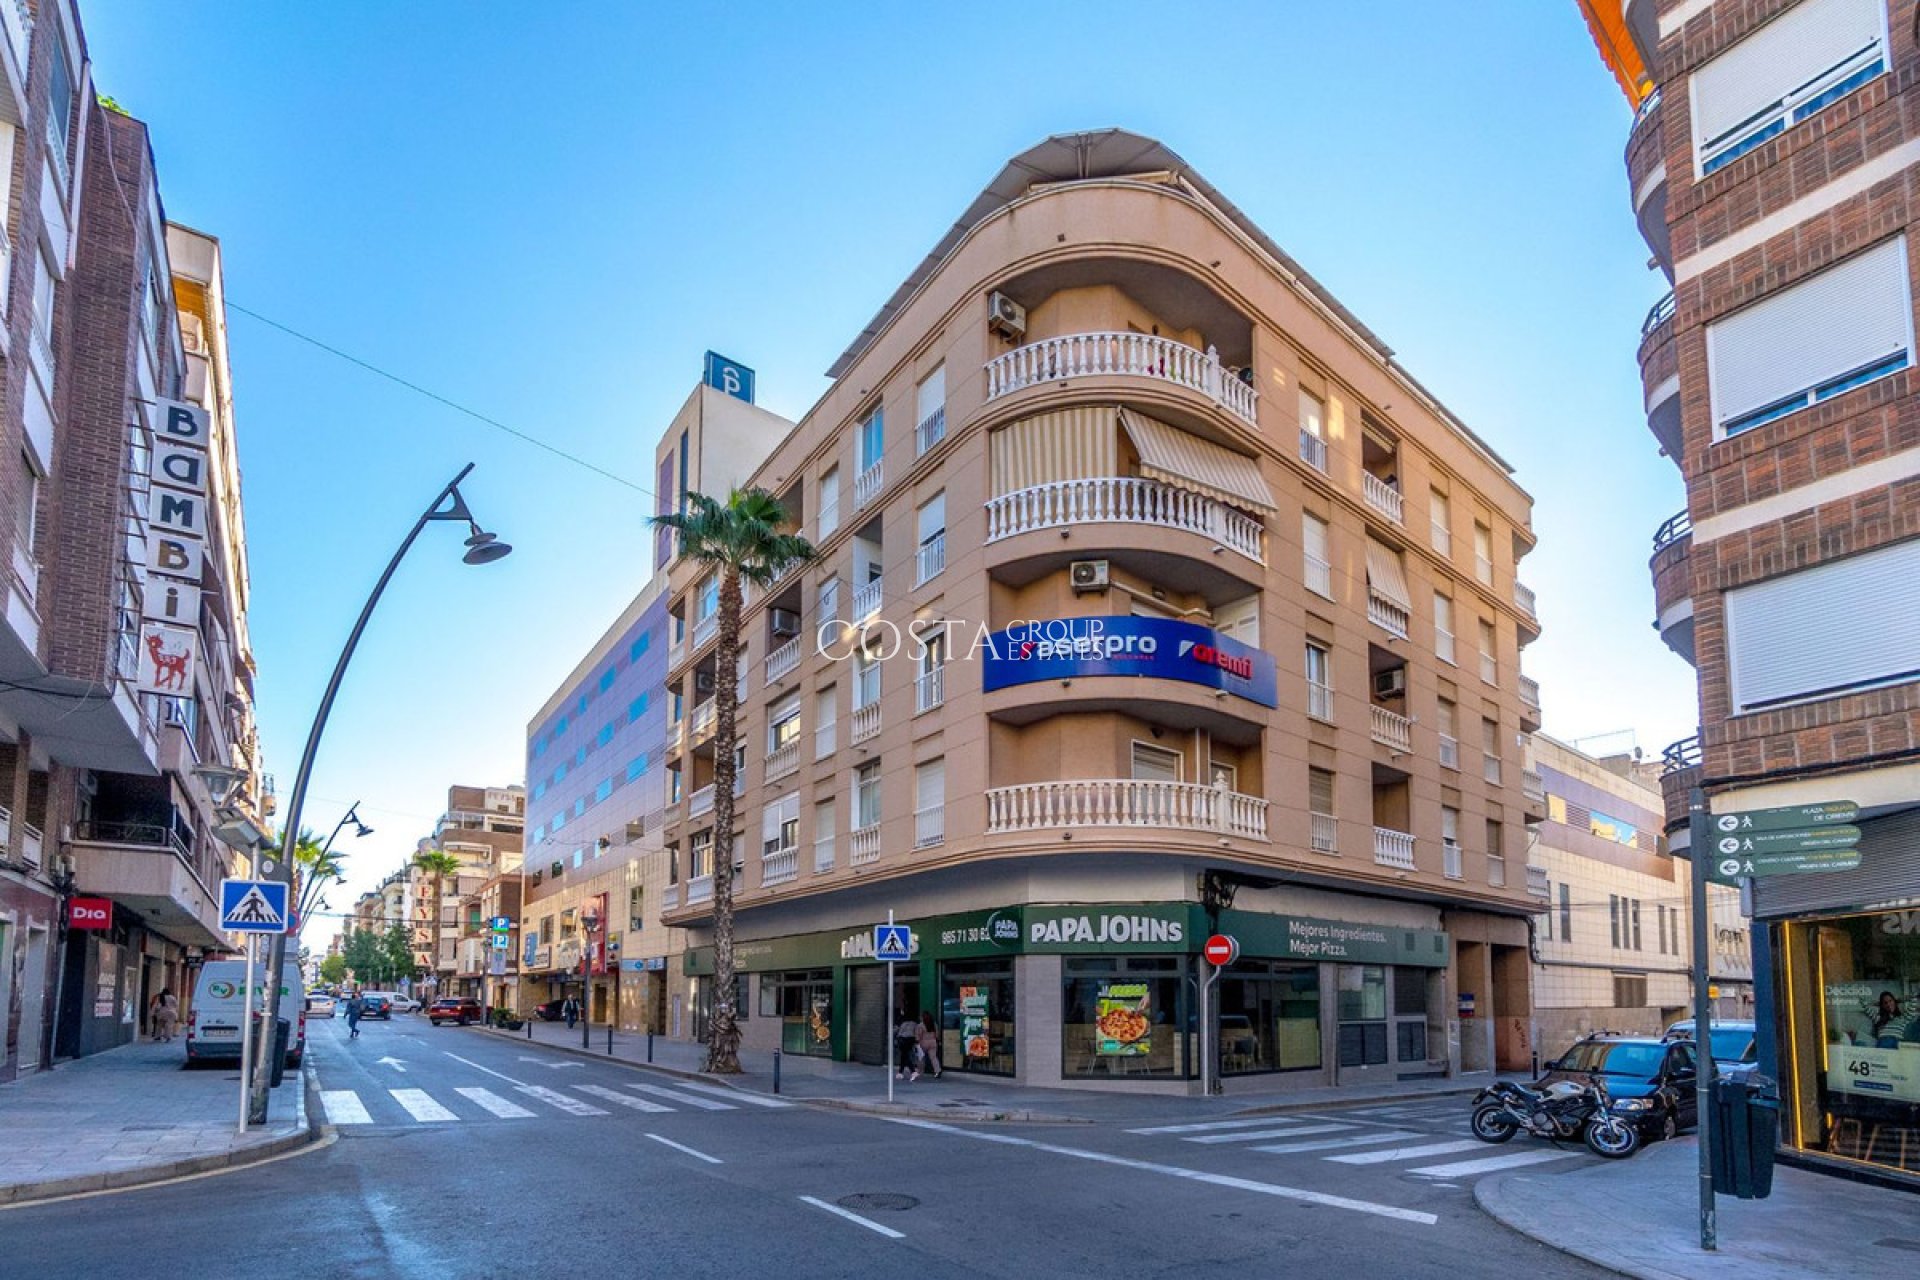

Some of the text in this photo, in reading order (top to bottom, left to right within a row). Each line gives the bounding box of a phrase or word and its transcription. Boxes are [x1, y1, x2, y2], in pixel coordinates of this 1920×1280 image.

[1031, 914, 1184, 943] PAPA JOHNS
[1289, 921, 1329, 939] Mejores
[1290, 939, 1319, 957] Mejor
[1849, 1060, 1870, 1077] 48
